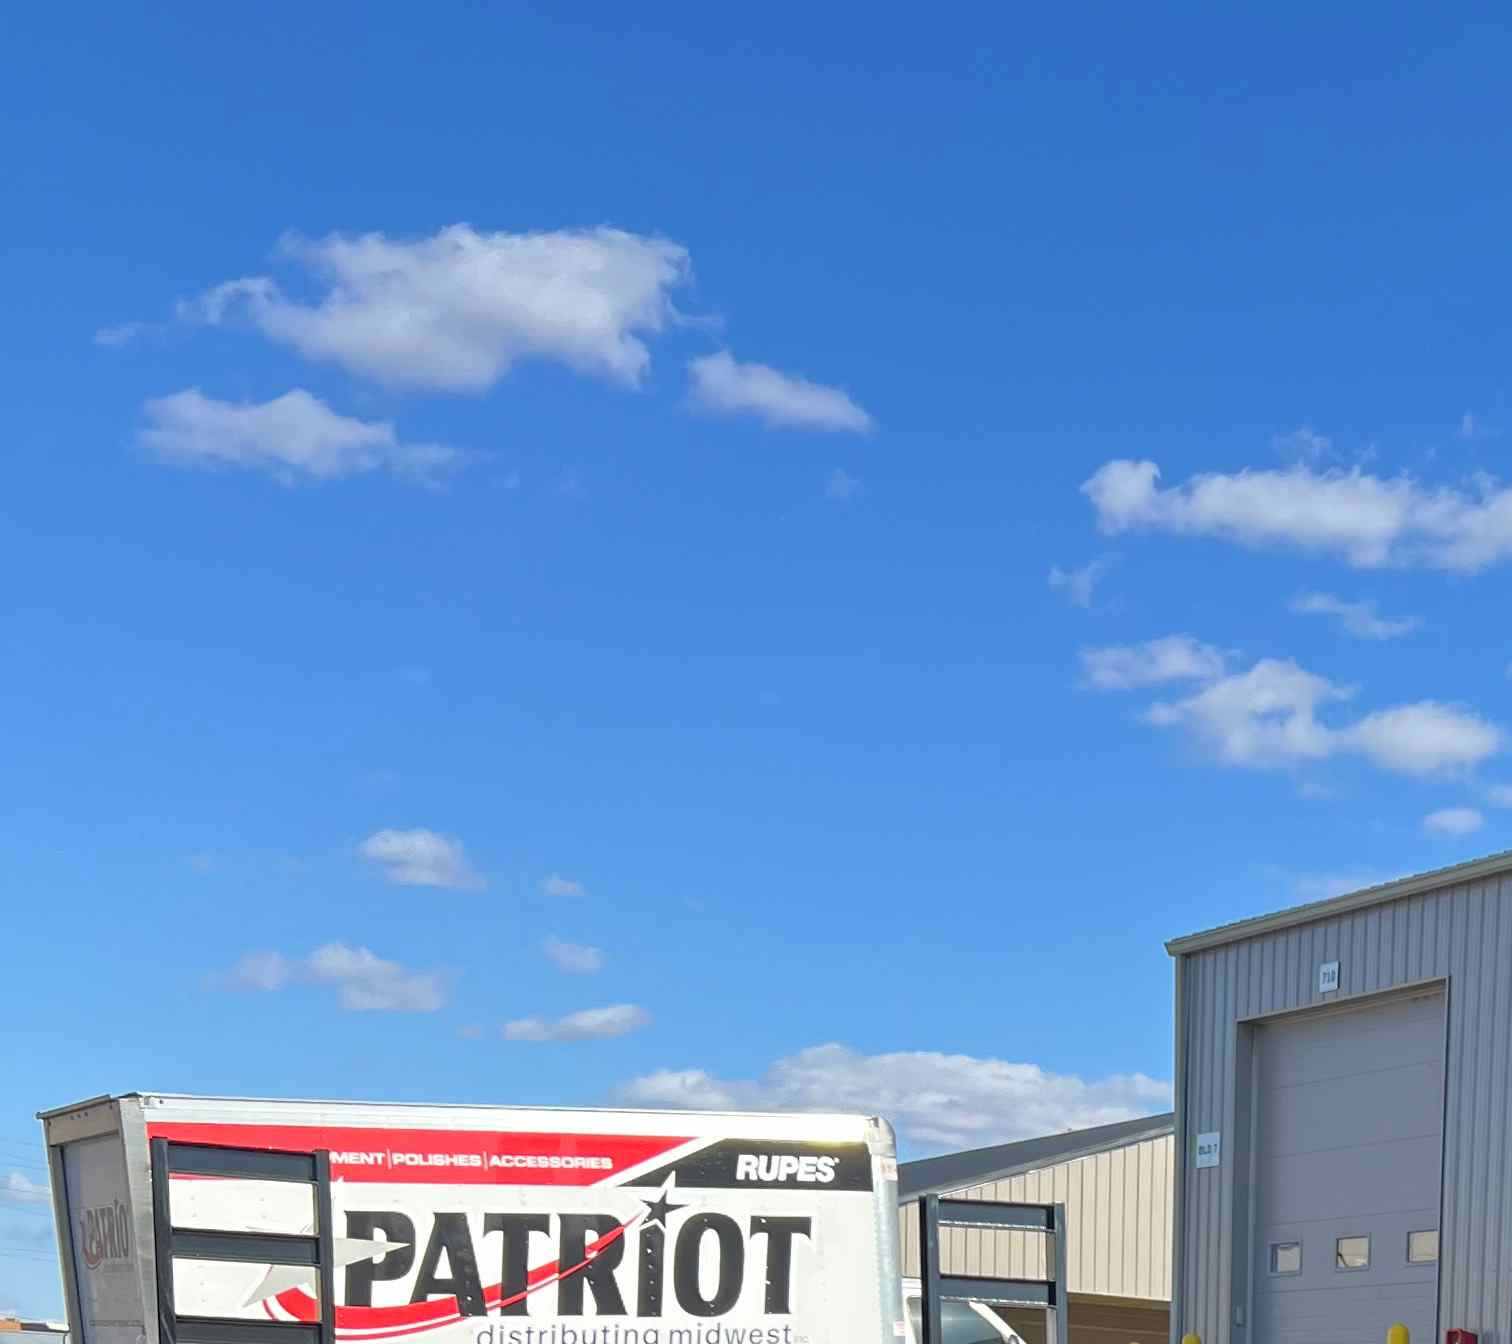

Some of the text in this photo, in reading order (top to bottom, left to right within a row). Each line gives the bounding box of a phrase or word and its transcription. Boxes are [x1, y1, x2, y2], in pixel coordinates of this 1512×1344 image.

[392, 1152, 481, 1167] POLISHES
[489, 1155, 614, 1170] ACCESSORIES
[735, 1154, 836, 1183] RUPES
[343, 1207, 813, 1318] PATRIOT
